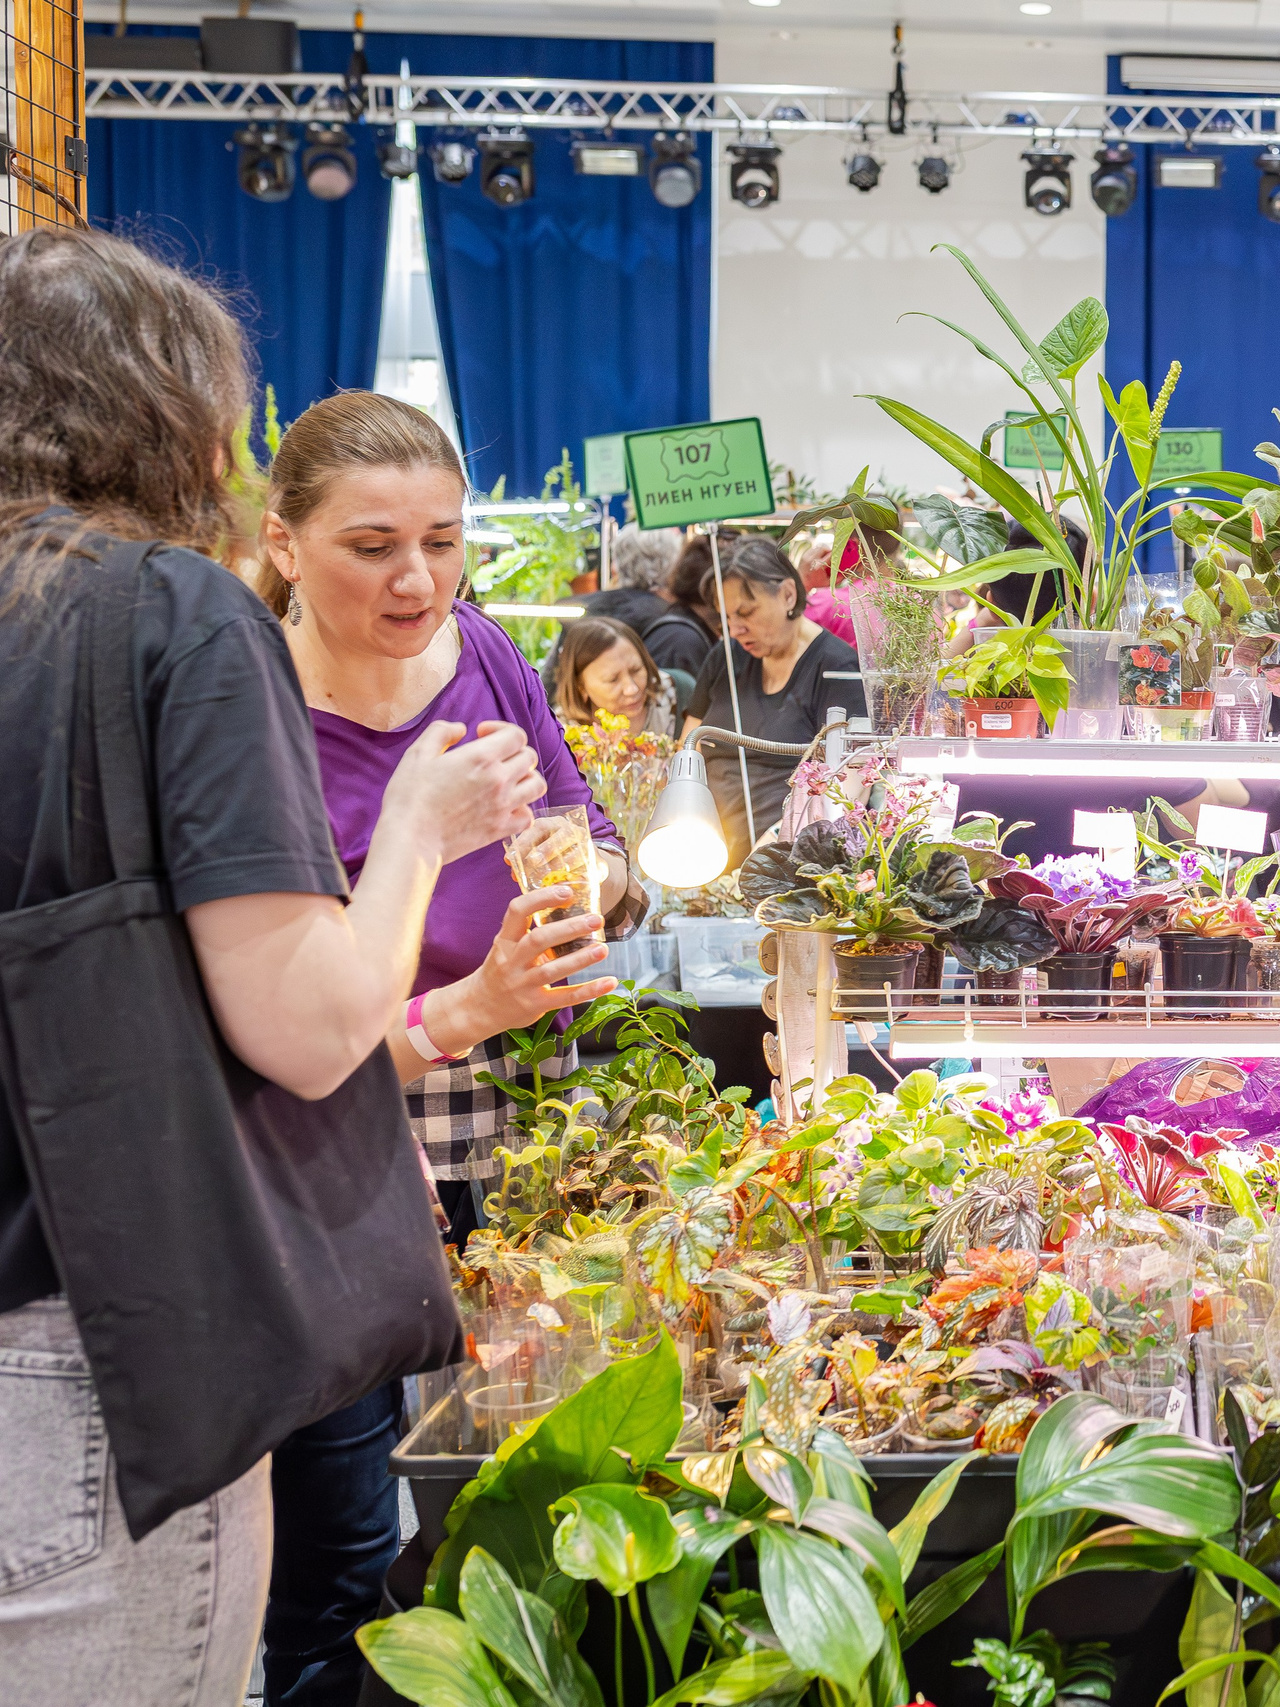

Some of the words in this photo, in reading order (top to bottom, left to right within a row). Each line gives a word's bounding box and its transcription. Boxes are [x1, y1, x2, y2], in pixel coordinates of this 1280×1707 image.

[674, 443, 712, 466] 107
[1165, 441, 1193, 456] 130
[644, 490, 693, 507] ЛИЕН
[700, 480, 757, 500] НГУЕН
[995, 700, 1014, 711] 600
